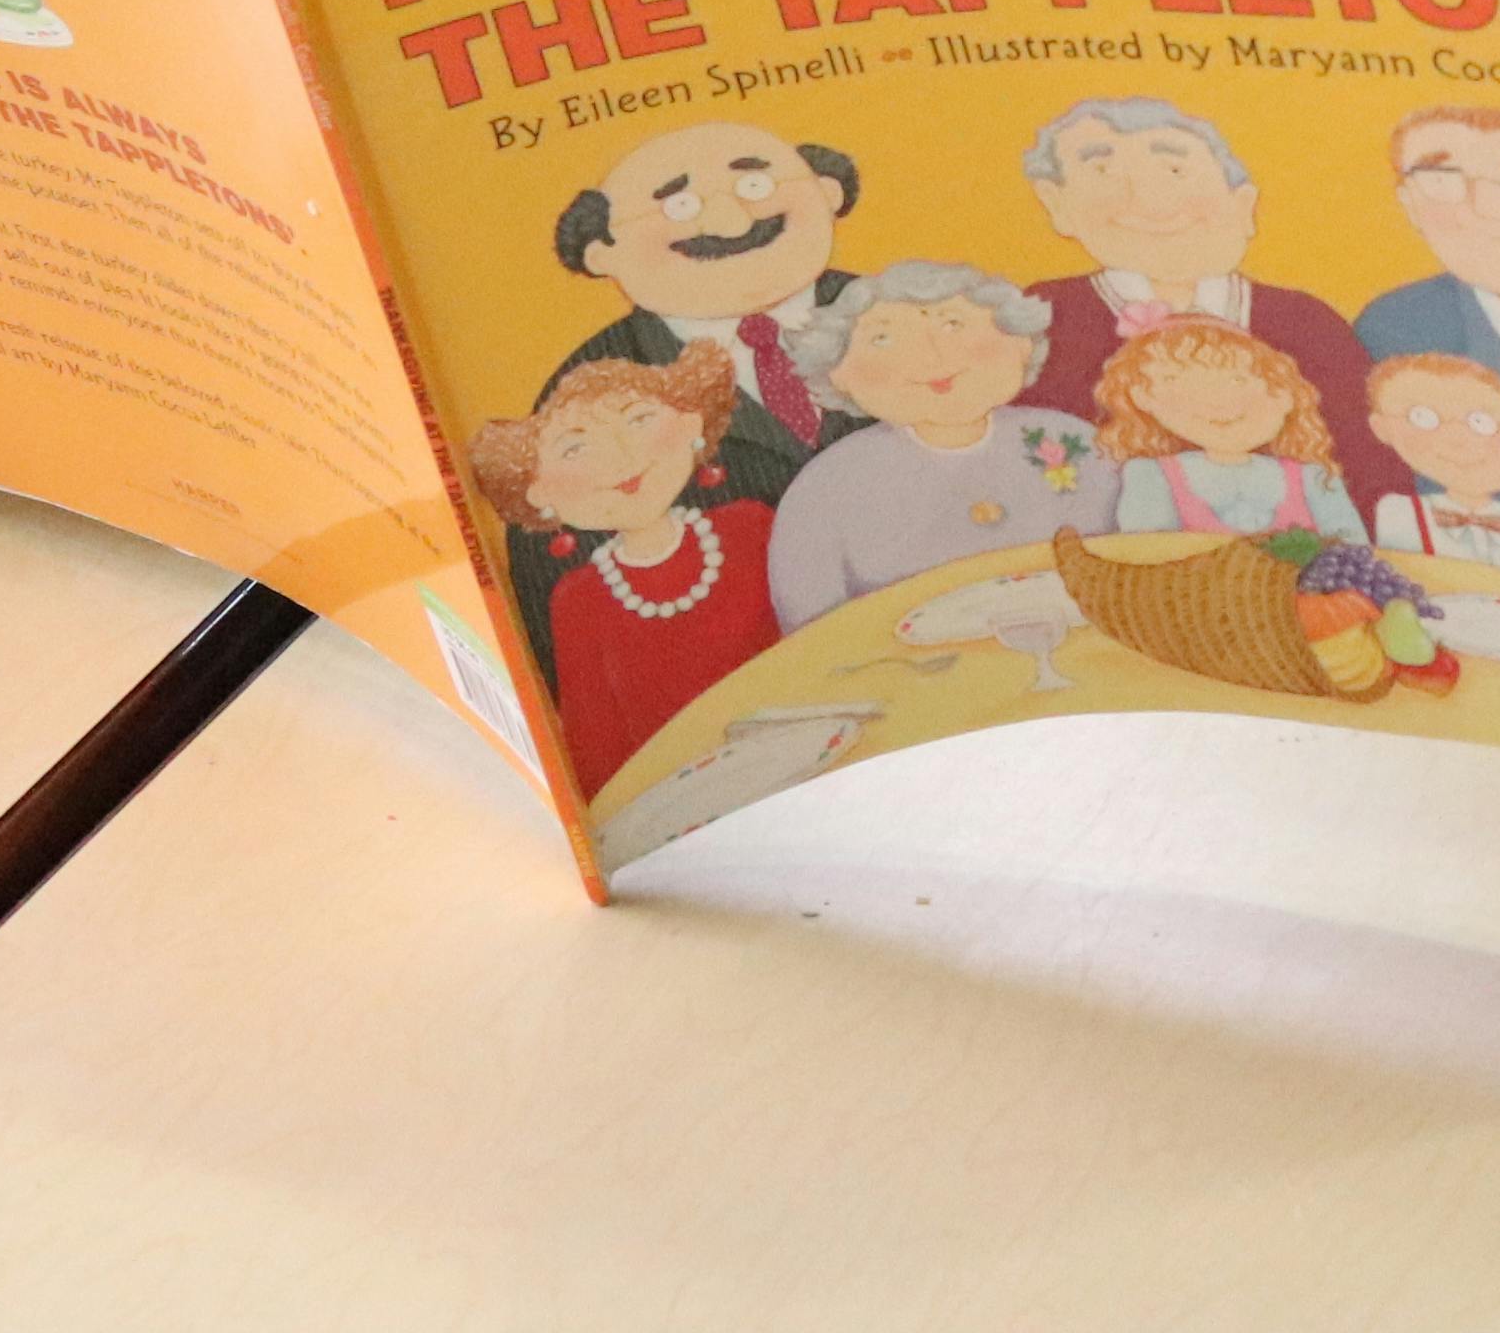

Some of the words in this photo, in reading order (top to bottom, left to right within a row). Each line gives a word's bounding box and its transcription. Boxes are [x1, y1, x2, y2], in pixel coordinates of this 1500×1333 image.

[4, 72, 50, 99] IS
[61, 89, 207, 165] ALWAYS
[489, 113, 545, 151] By
[561, 78, 694, 129] Eileen
[707, 46, 867, 103] Spinelli
[926, 32, 1142, 67] Illustrated
[1163, 33, 1211, 71] by
[1227, 35, 1415, 79] Maryann
[375, 284, 436, 417] THANKSGIVING
[423, 417, 443, 441] AT
[433, 444, 456, 478] THE
